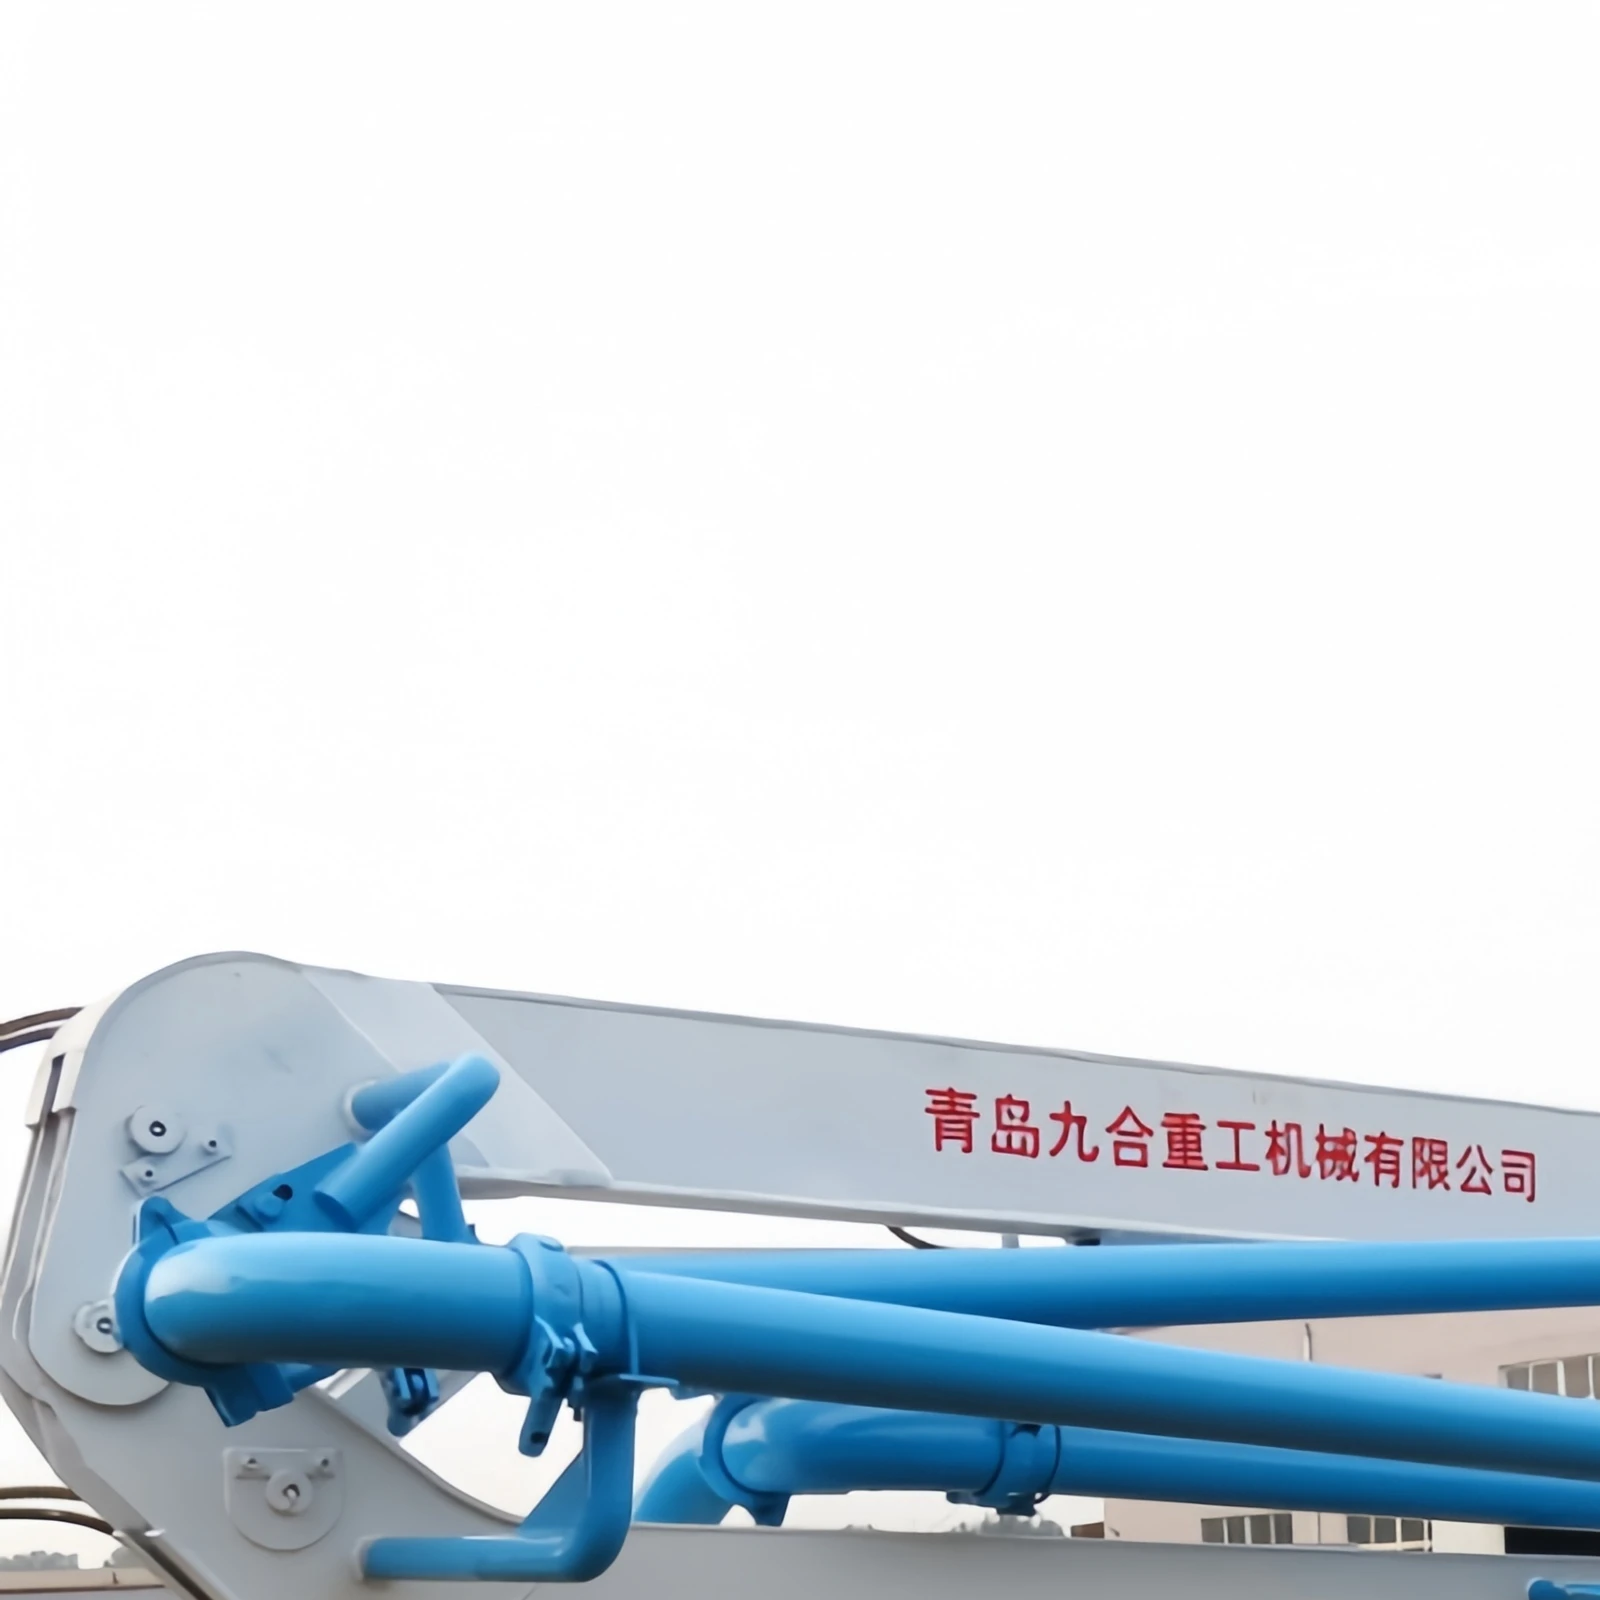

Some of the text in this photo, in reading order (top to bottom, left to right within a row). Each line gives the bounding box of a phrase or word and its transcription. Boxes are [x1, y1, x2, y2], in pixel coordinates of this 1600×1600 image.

[924, 1086, 1536, 1202] 青岛九合重工机械有限公司
